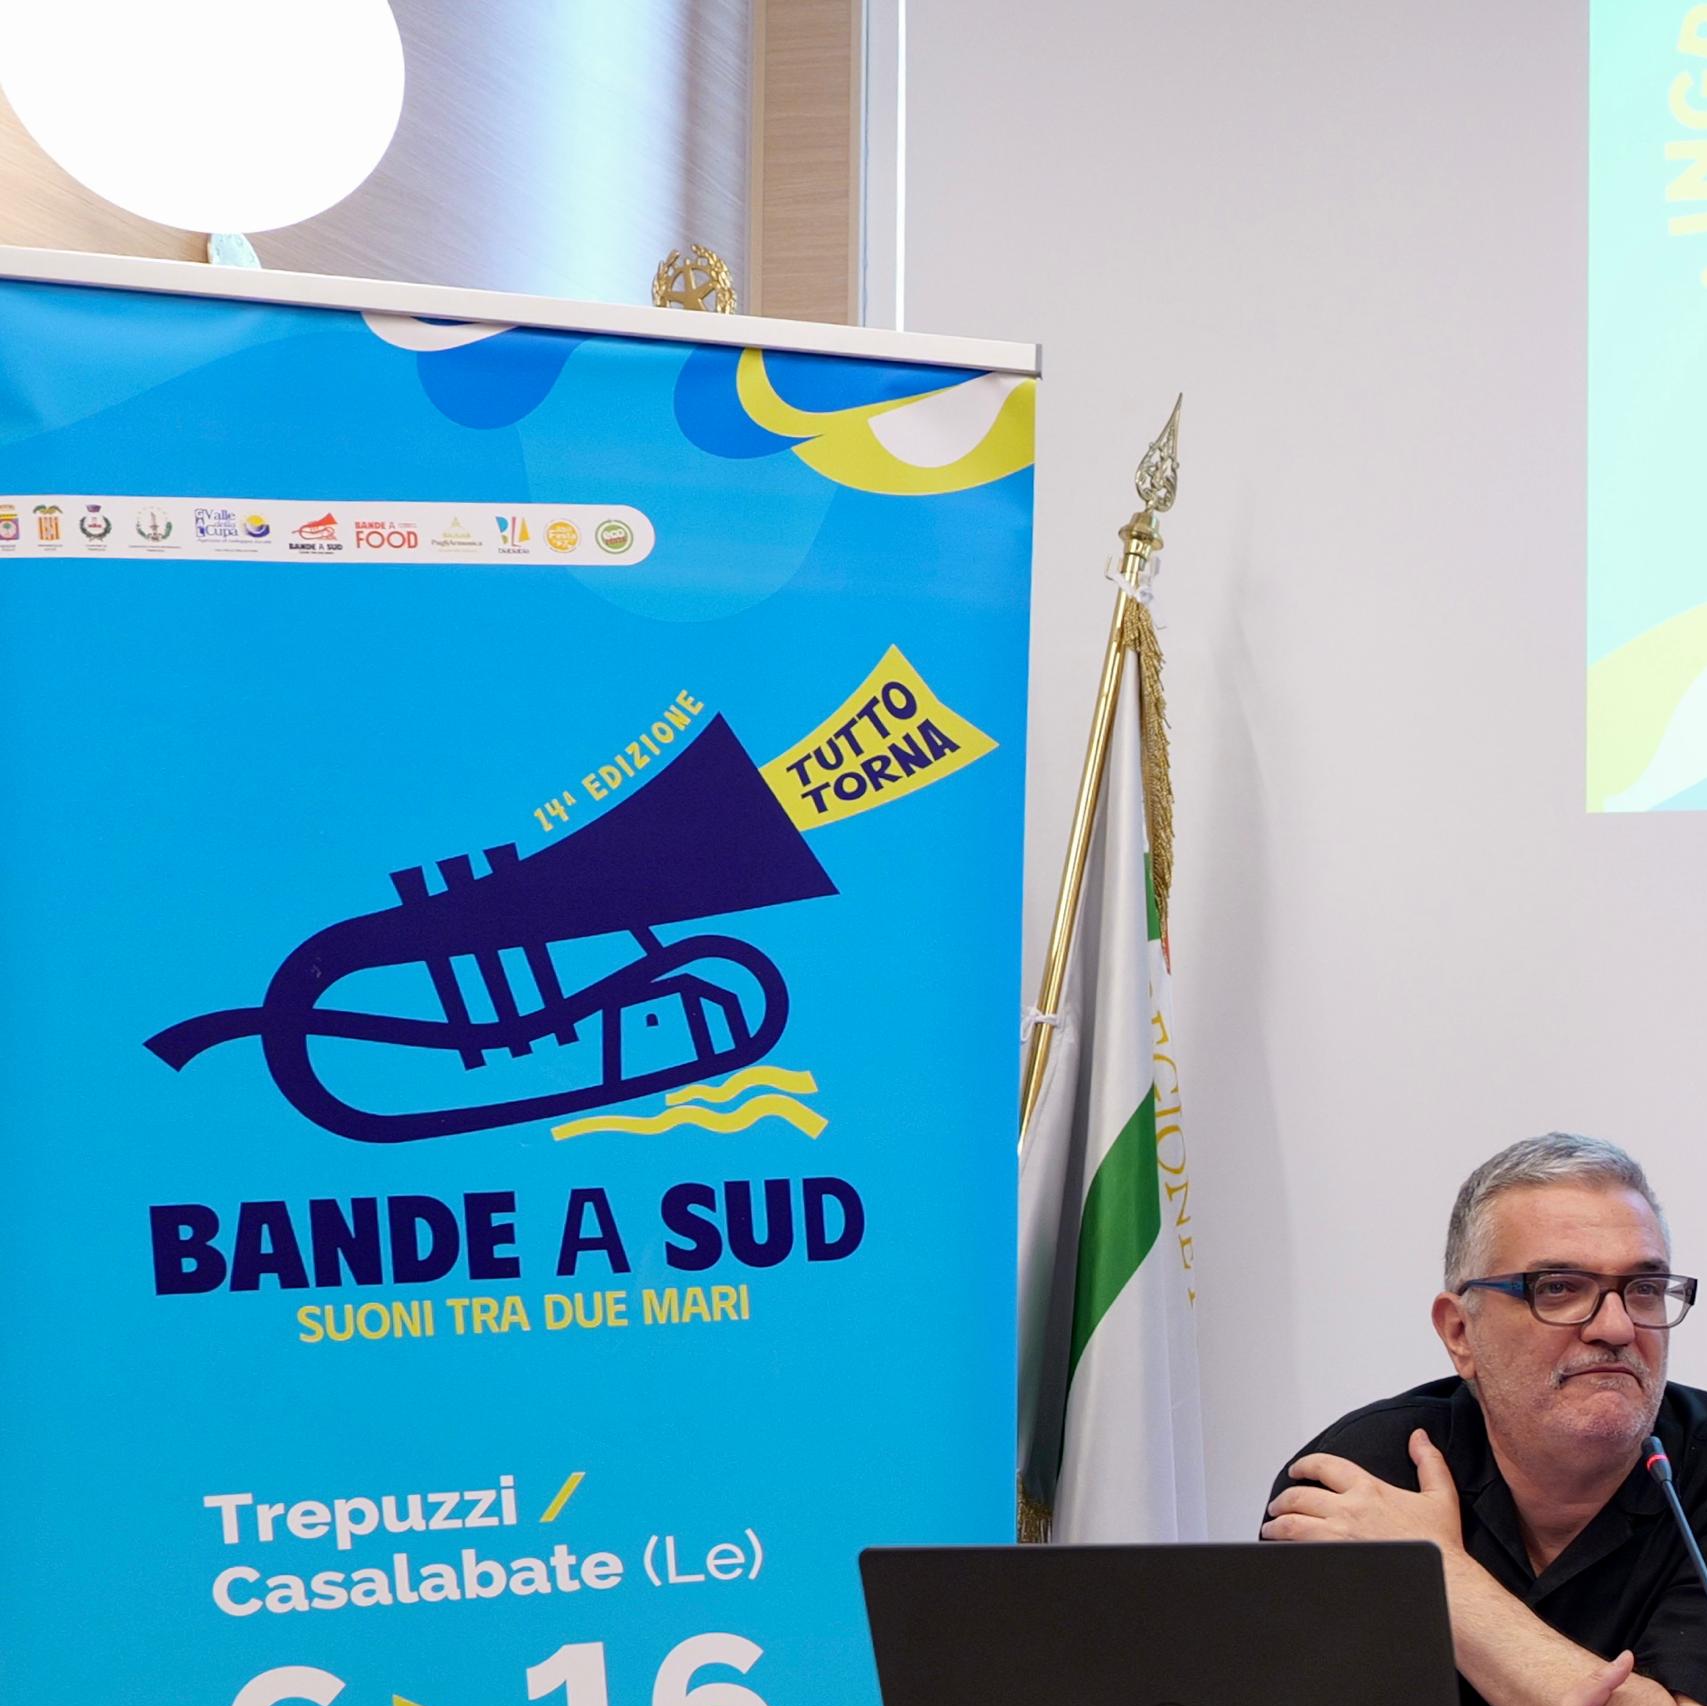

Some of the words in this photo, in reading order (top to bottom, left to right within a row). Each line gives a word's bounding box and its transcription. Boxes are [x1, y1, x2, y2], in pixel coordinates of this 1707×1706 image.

[355, 521, 386, 530] BANDE
[355, 530, 419, 549] FOOD
[582, 687, 707, 804] EDIZIONE
[786, 680, 919, 783] TUTTO
[800, 719, 960, 817] TORNA
[147, 1190, 523, 1298] BANDE
[556, 1185, 632, 1276] A
[663, 1174, 867, 1274] SUD
[295, 1299, 435, 1346] SUONI
[446, 1293, 532, 1337] TRA
[544, 1289, 629, 1333] DUE
[641, 1282, 751, 1327] MARI
[202, 1474, 519, 1551] Trepuzzi
[211, 1541, 625, 1620] Casalabate
[641, 1527, 765, 1594] (Le)
